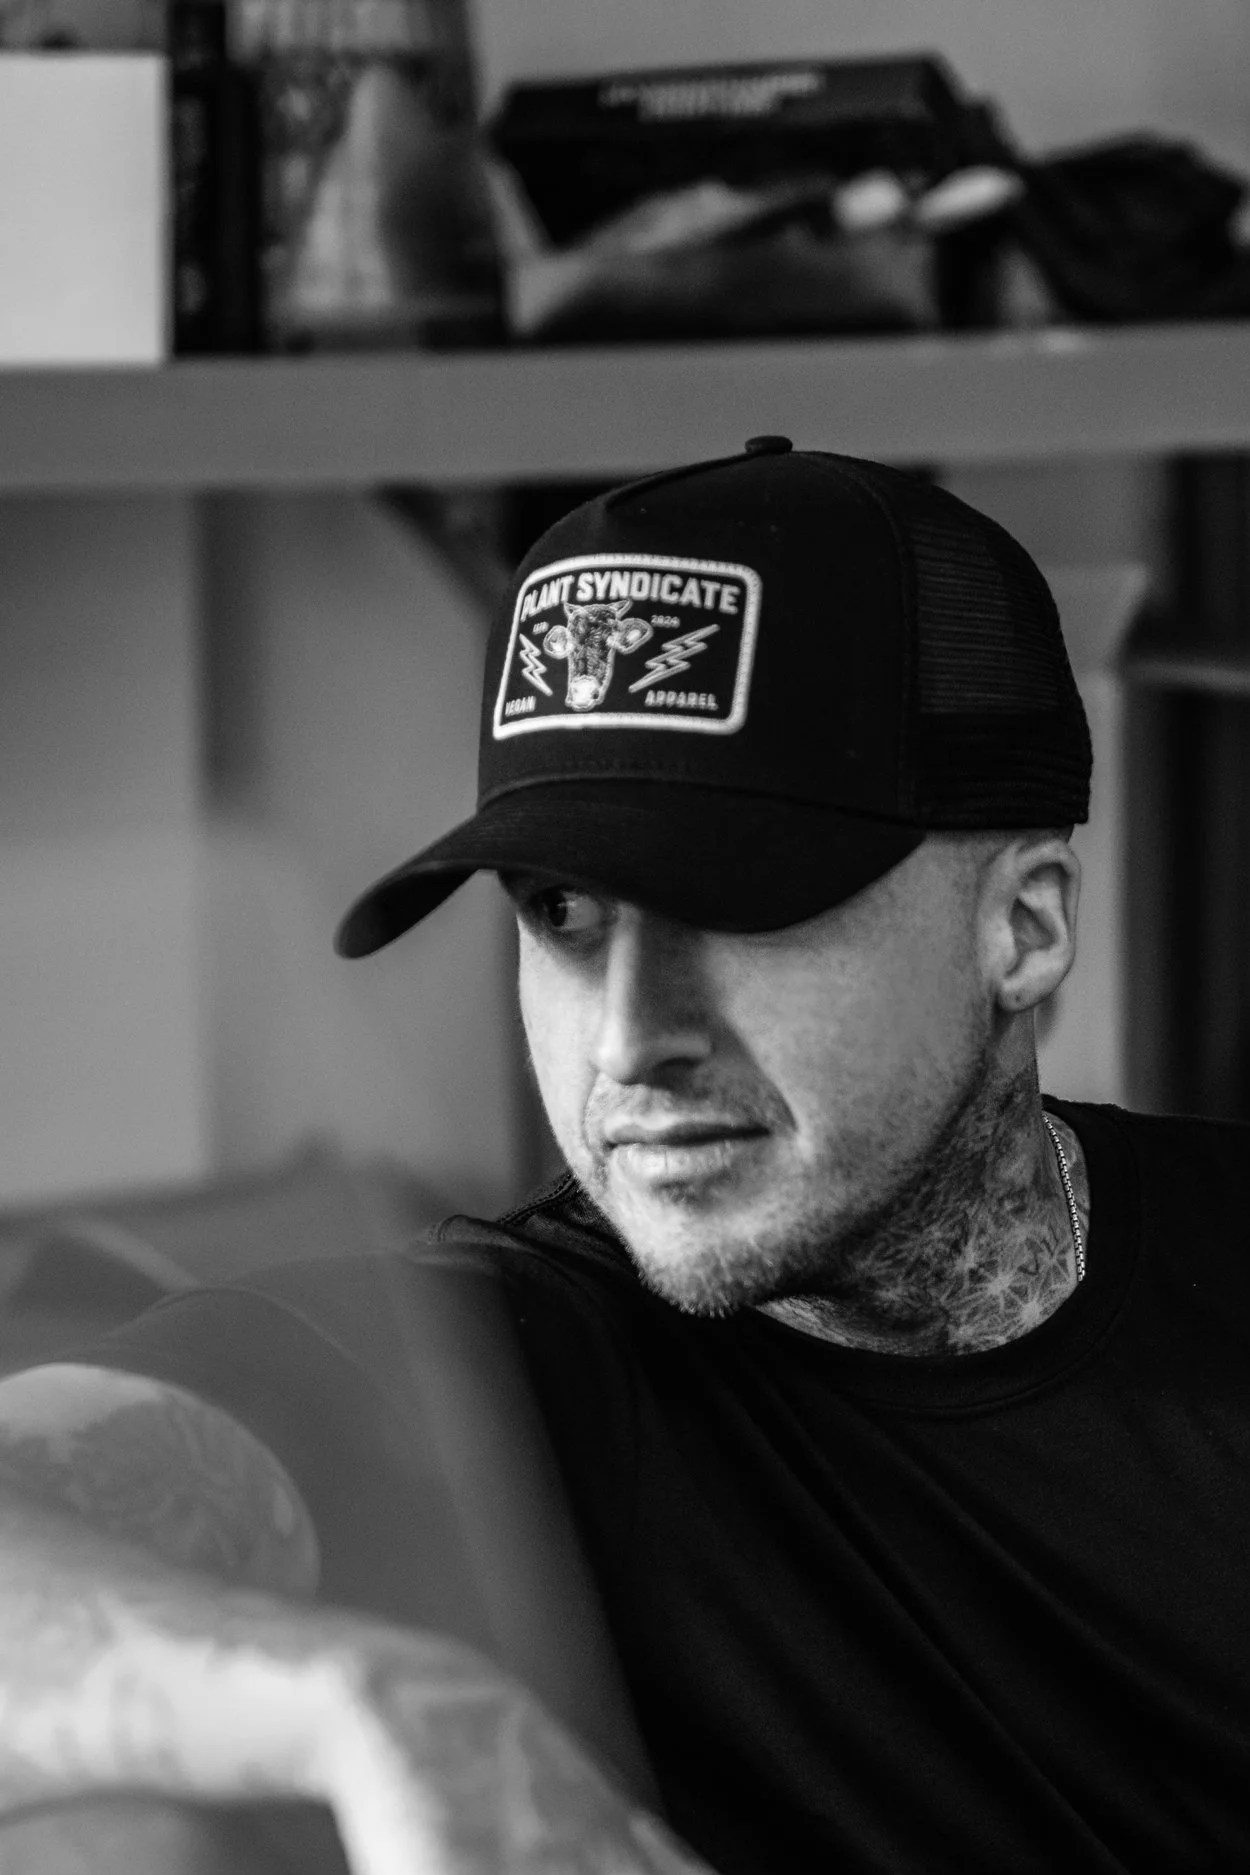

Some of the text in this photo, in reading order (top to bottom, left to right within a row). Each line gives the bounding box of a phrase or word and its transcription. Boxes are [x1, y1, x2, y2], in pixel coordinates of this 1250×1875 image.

[521, 571, 741, 622] PLANT SYNDICATE
[505, 696, 536, 716] VEGAN
[644, 690, 719, 711] APPAREL
